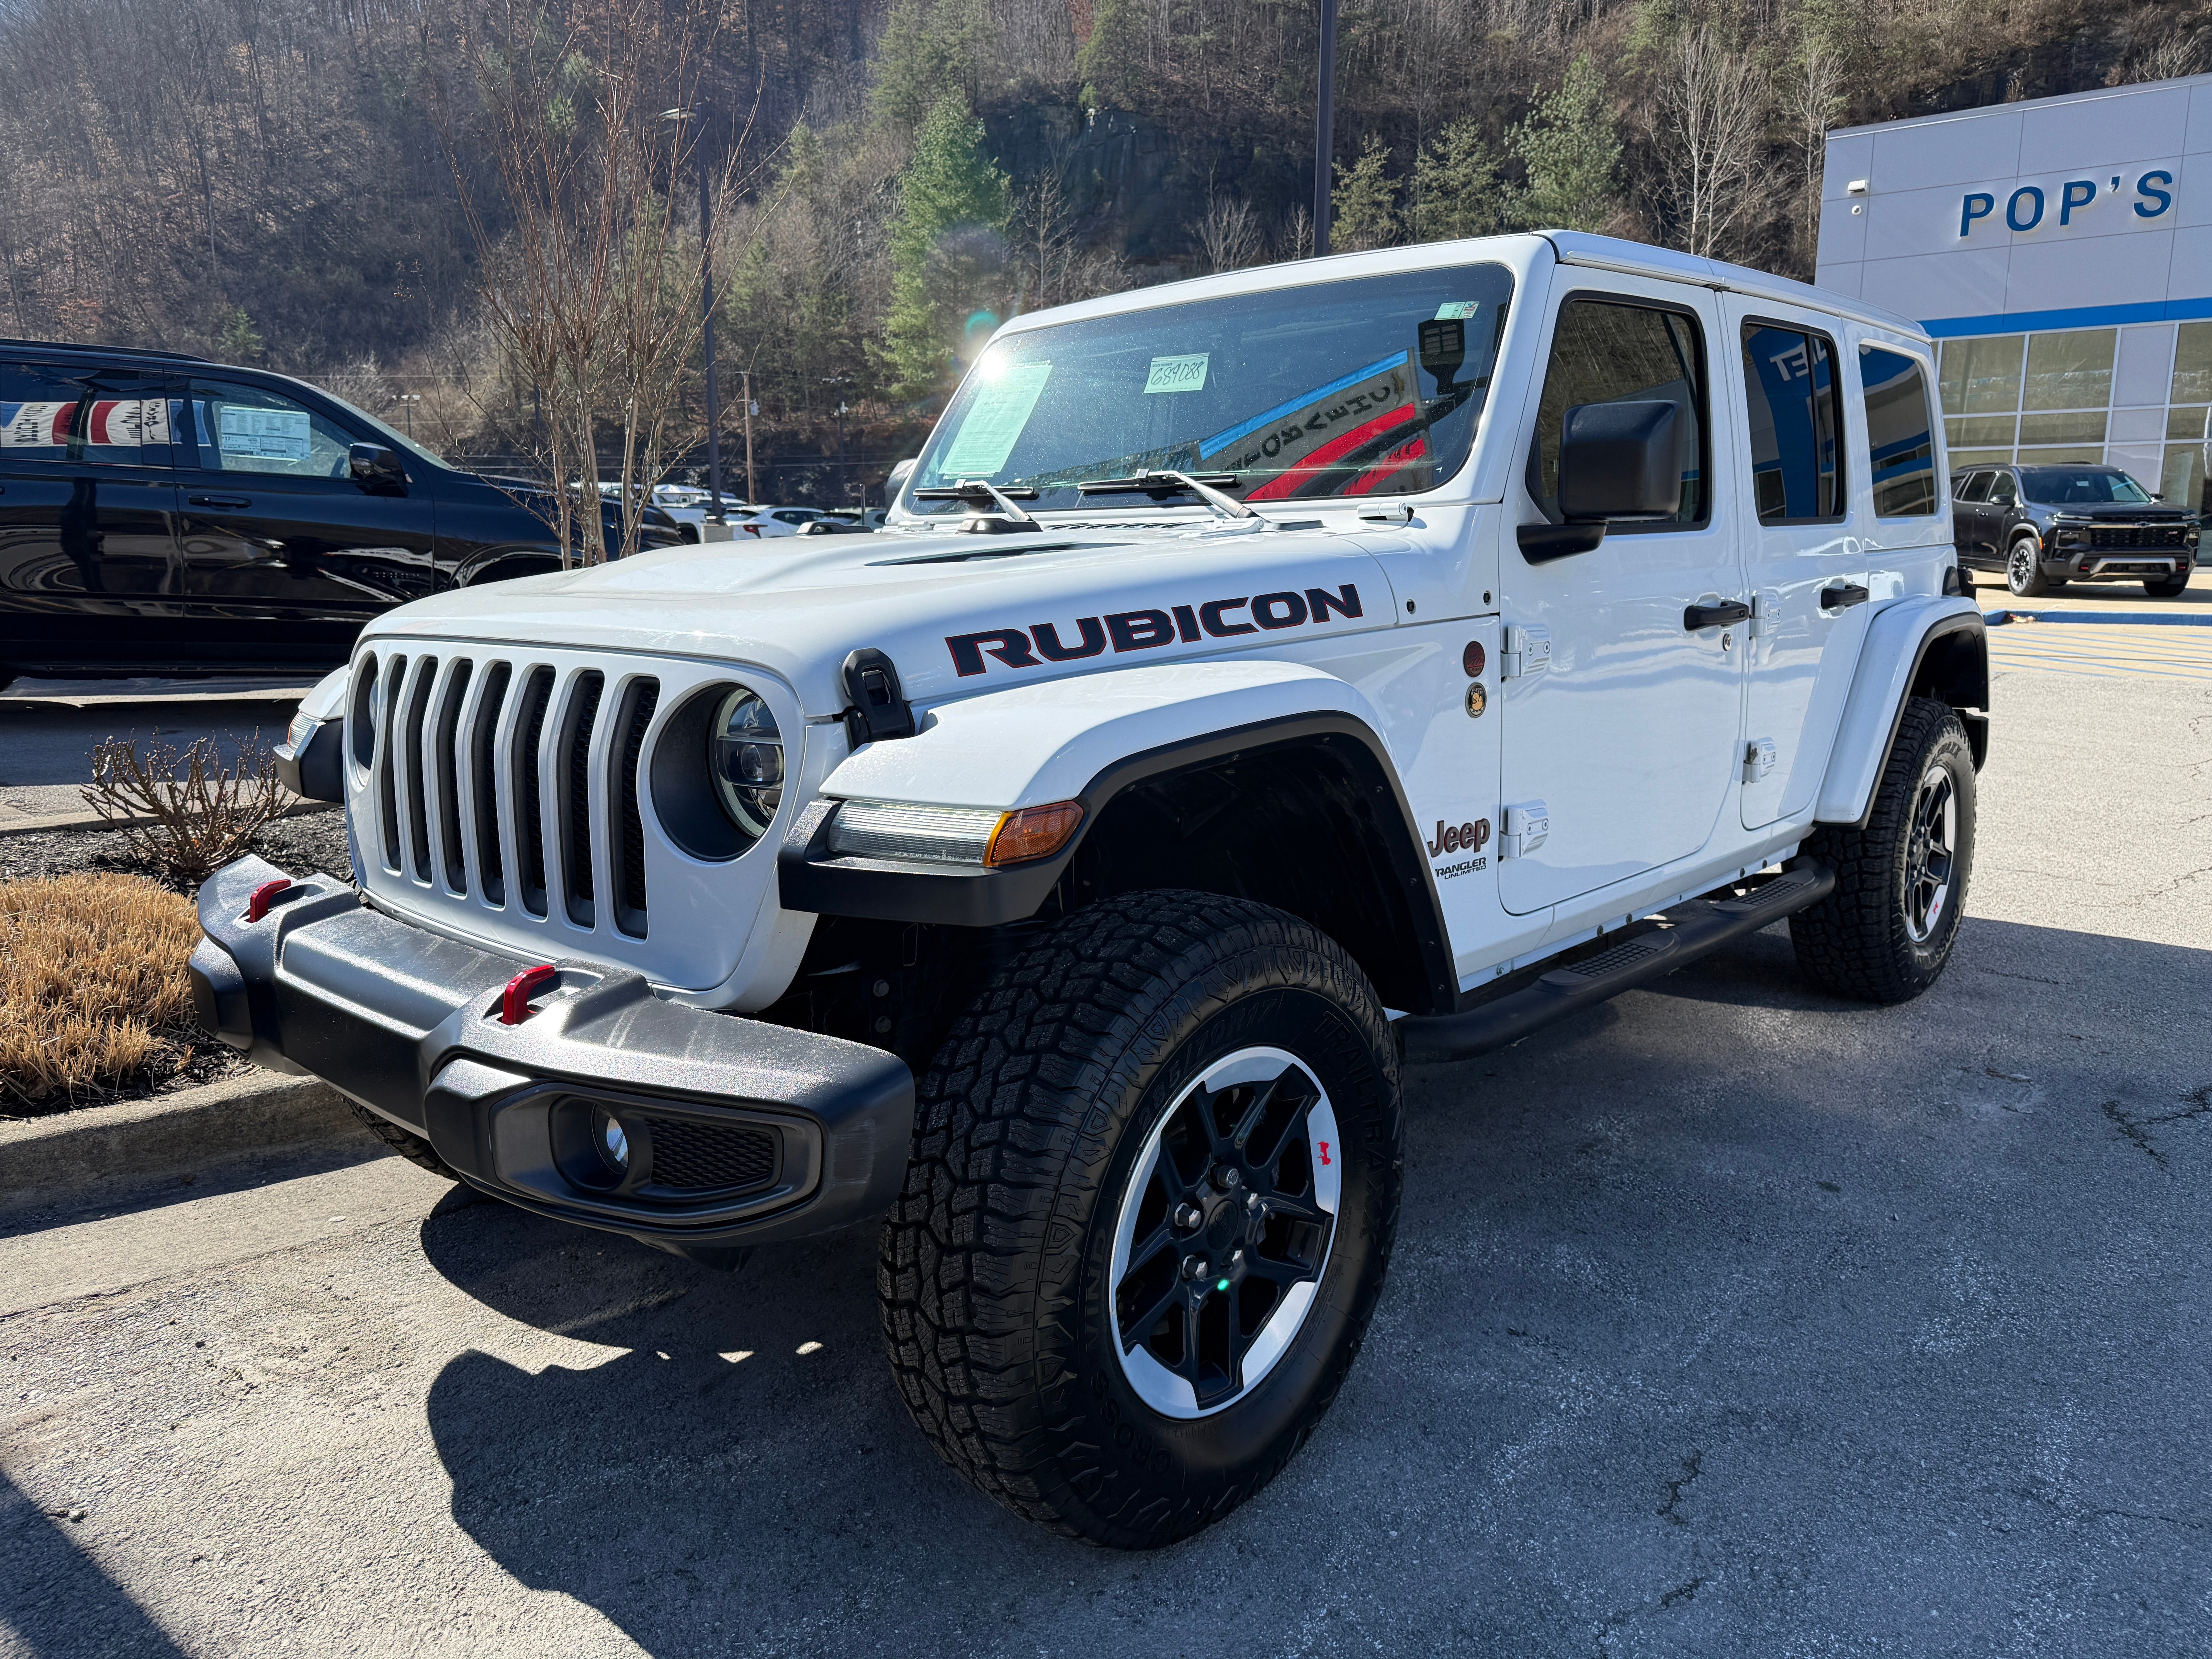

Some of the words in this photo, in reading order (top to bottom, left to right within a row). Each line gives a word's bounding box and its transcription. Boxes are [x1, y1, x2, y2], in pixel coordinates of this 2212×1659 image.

[1960, 170, 2172, 237] POP'S
[944, 583, 1364, 677] RUBICON
[1427, 818, 1491, 858] Jeep
[1435, 857, 1486, 877] RANGLER
[1444, 865, 1486, 879] UNLIMITED
